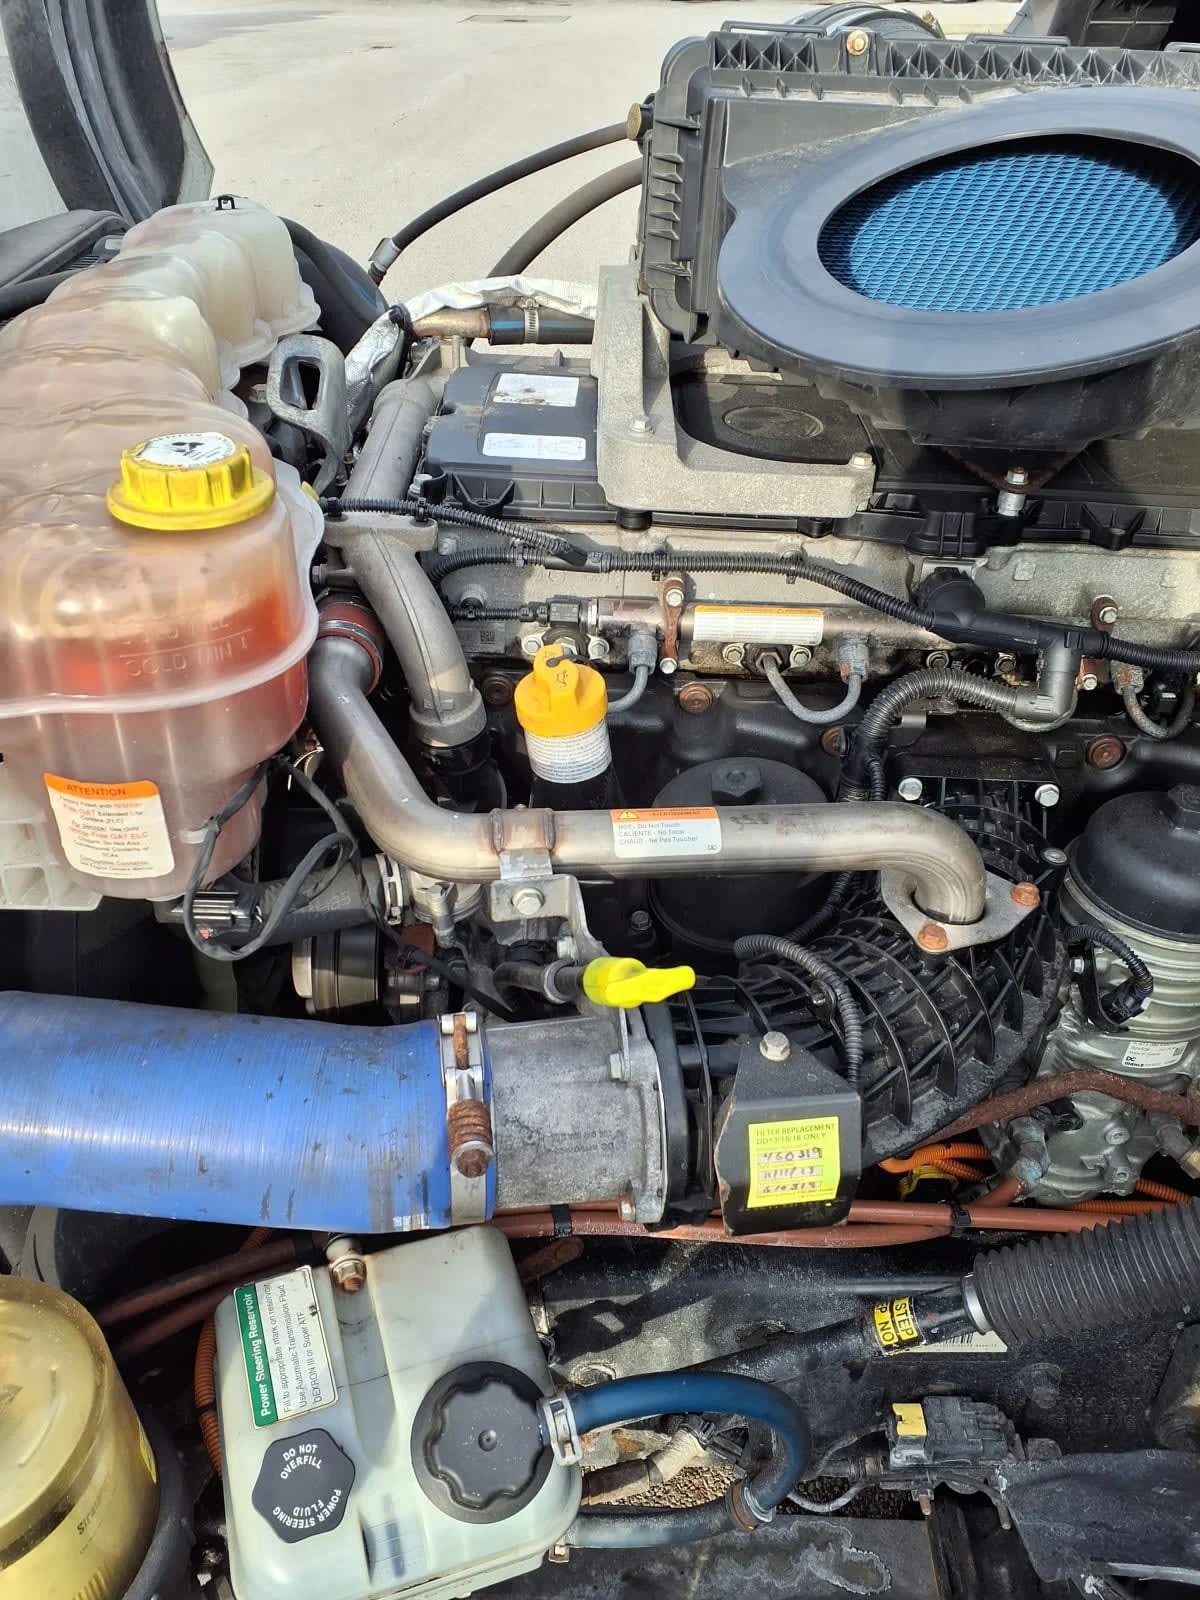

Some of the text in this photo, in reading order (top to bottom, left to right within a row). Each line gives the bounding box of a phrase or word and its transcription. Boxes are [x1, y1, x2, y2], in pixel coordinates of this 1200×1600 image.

[66, 784, 126, 796] ATTENTION
[756, 1123, 835, 1137] FILTER REPLACEMENT
[803, 1132, 826, 1141] ONLY
[269, 1315, 277, 1325] on
[296, 1311, 306, 1325] ATF
[894, 1302, 914, 1338] STEP
[271, 1325, 281, 1345] mark
[301, 1326, 313, 1348] Super
[878, 1321, 895, 1342] NO
[243, 1293, 271, 1417] Power Steering Reservoir
[277, 1284, 308, 1408] Use Automatic Transmission Fluid
[275, 1346, 289, 1389] appropriate
[308, 1366, 323, 1403] DEXRON
[281, 1399, 292, 1413] Fill
[282, 1444, 318, 1461] DO NOT
[280, 1455, 322, 1479] OVERFILL
[272, 1489, 342, 1529] POWER STEERING
[292, 1499, 325, 1517] FLUID
